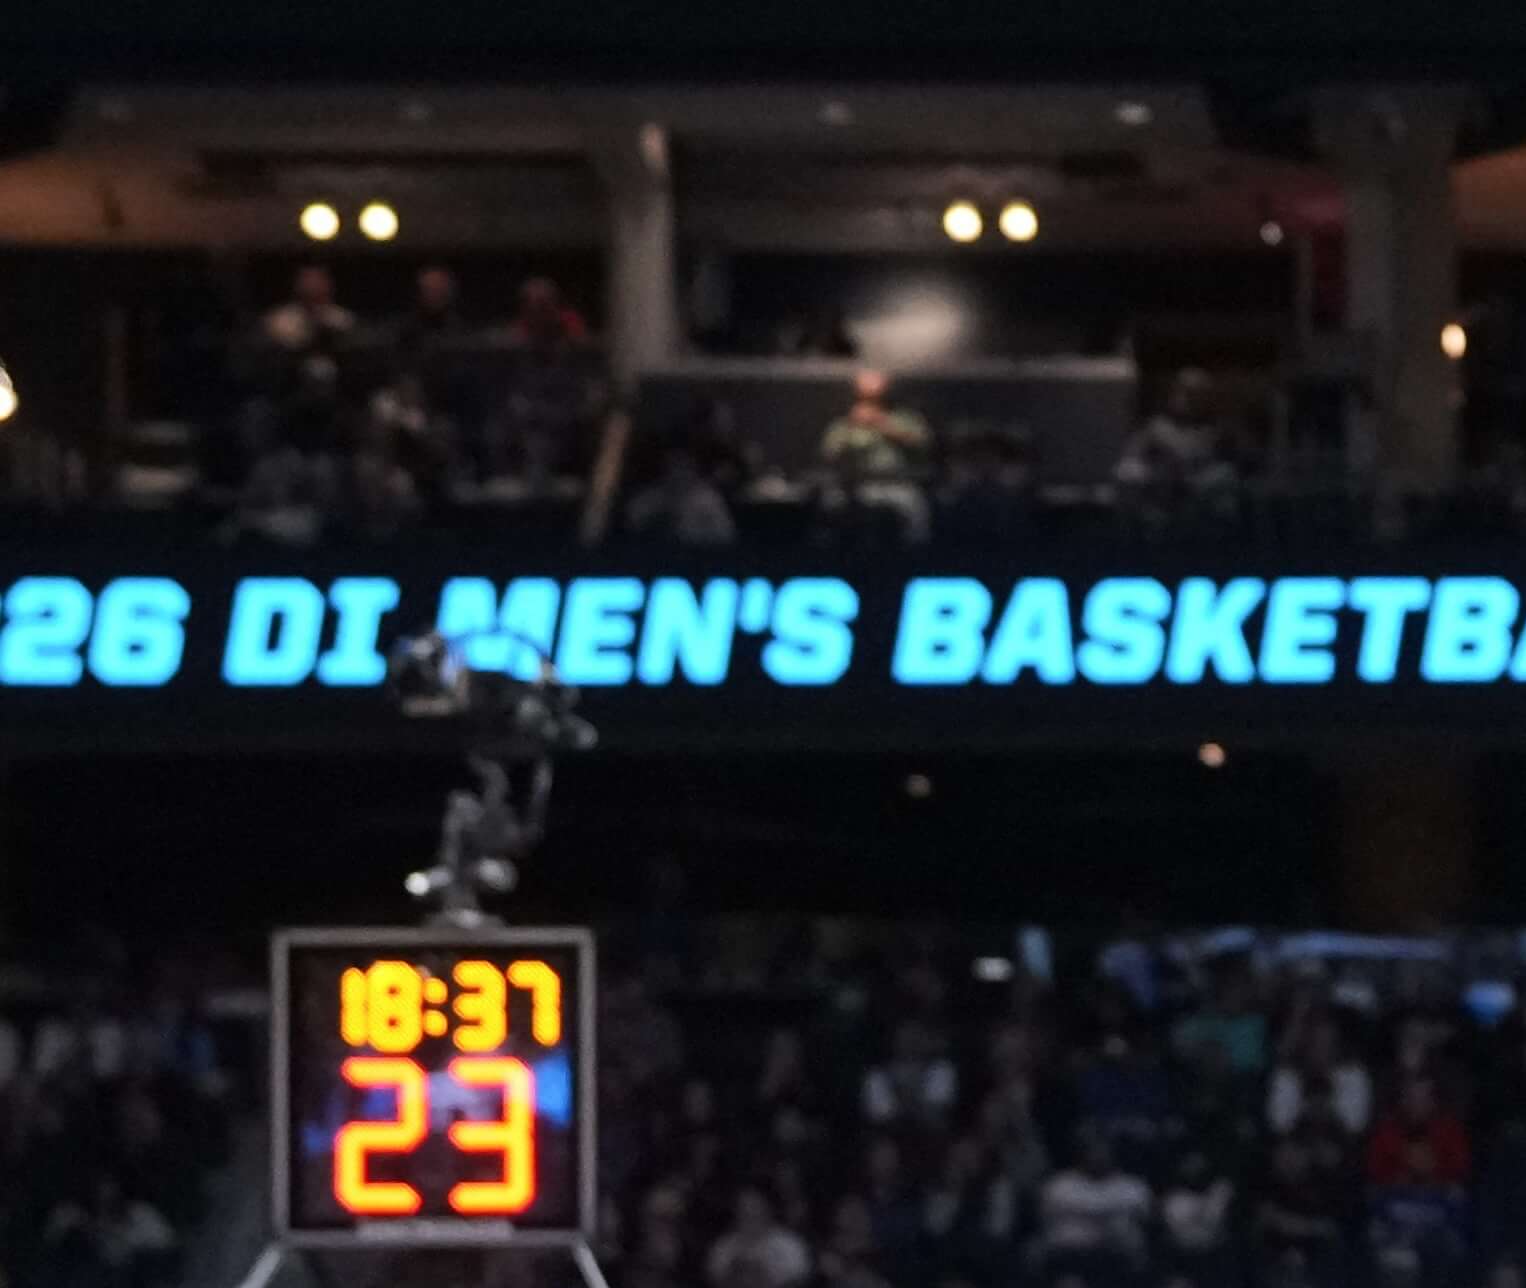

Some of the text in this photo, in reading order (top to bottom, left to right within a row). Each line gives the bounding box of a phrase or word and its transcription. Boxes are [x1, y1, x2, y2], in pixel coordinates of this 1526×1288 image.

[221, 575, 400, 687] DI
[435, 575, 860, 687] MEN'S
[340, 958, 562, 1054] 18:37
[333, 1054, 537, 1215] 23
